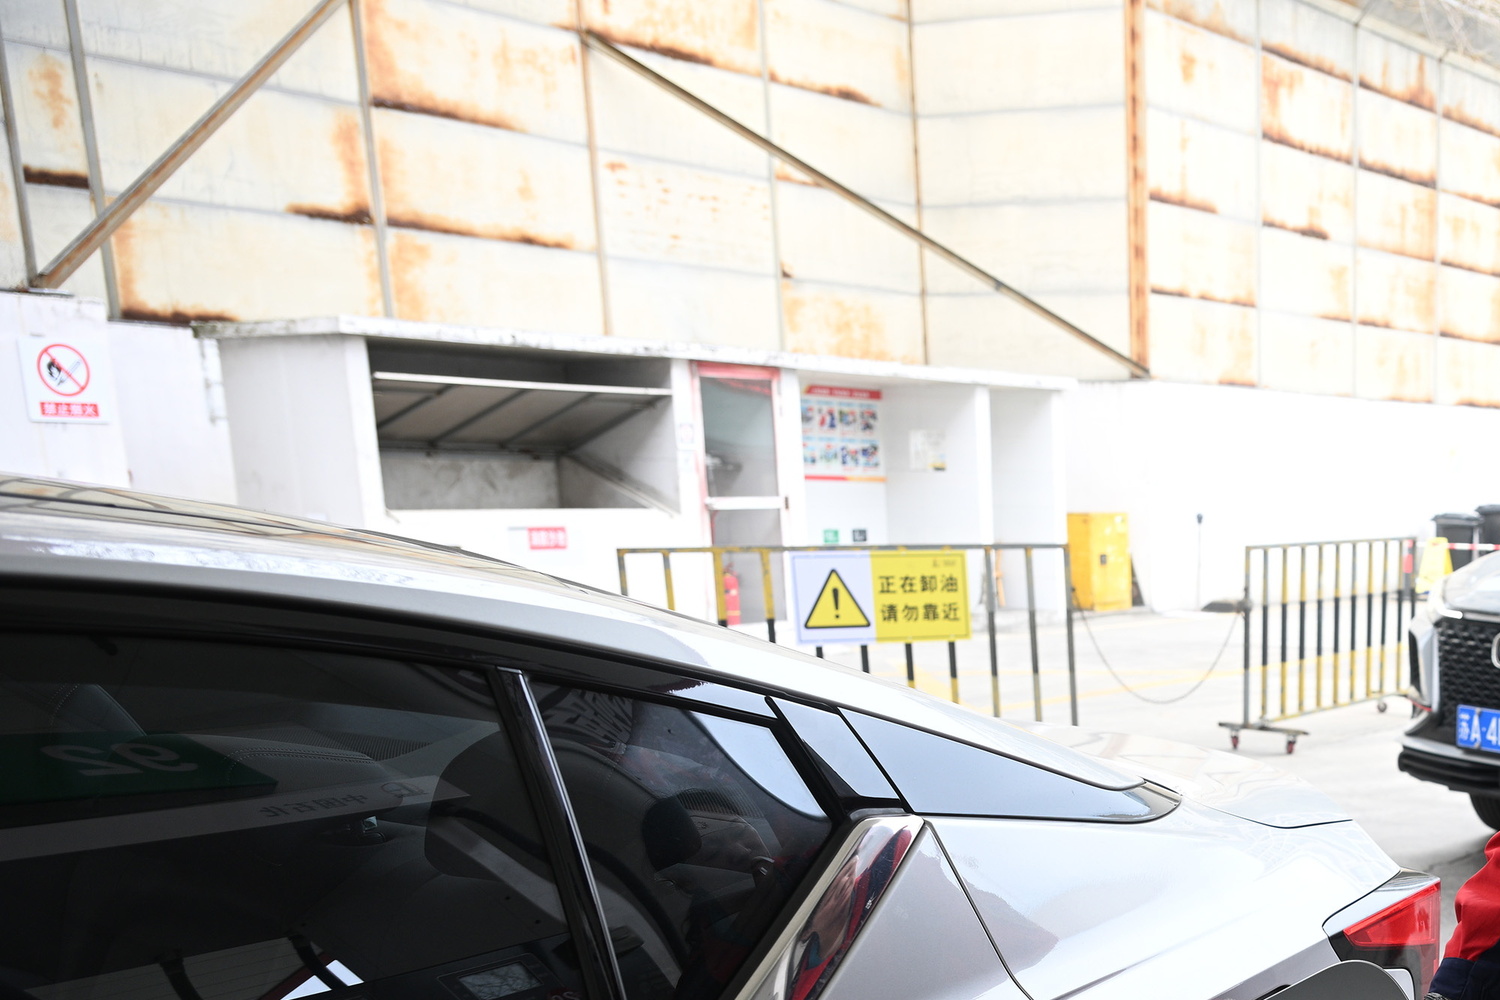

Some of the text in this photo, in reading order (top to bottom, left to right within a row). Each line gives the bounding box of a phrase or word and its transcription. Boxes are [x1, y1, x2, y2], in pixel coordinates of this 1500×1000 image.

[878, 574, 958, 594] 正在卸油
[881, 602, 961, 622] 请勿靠近
